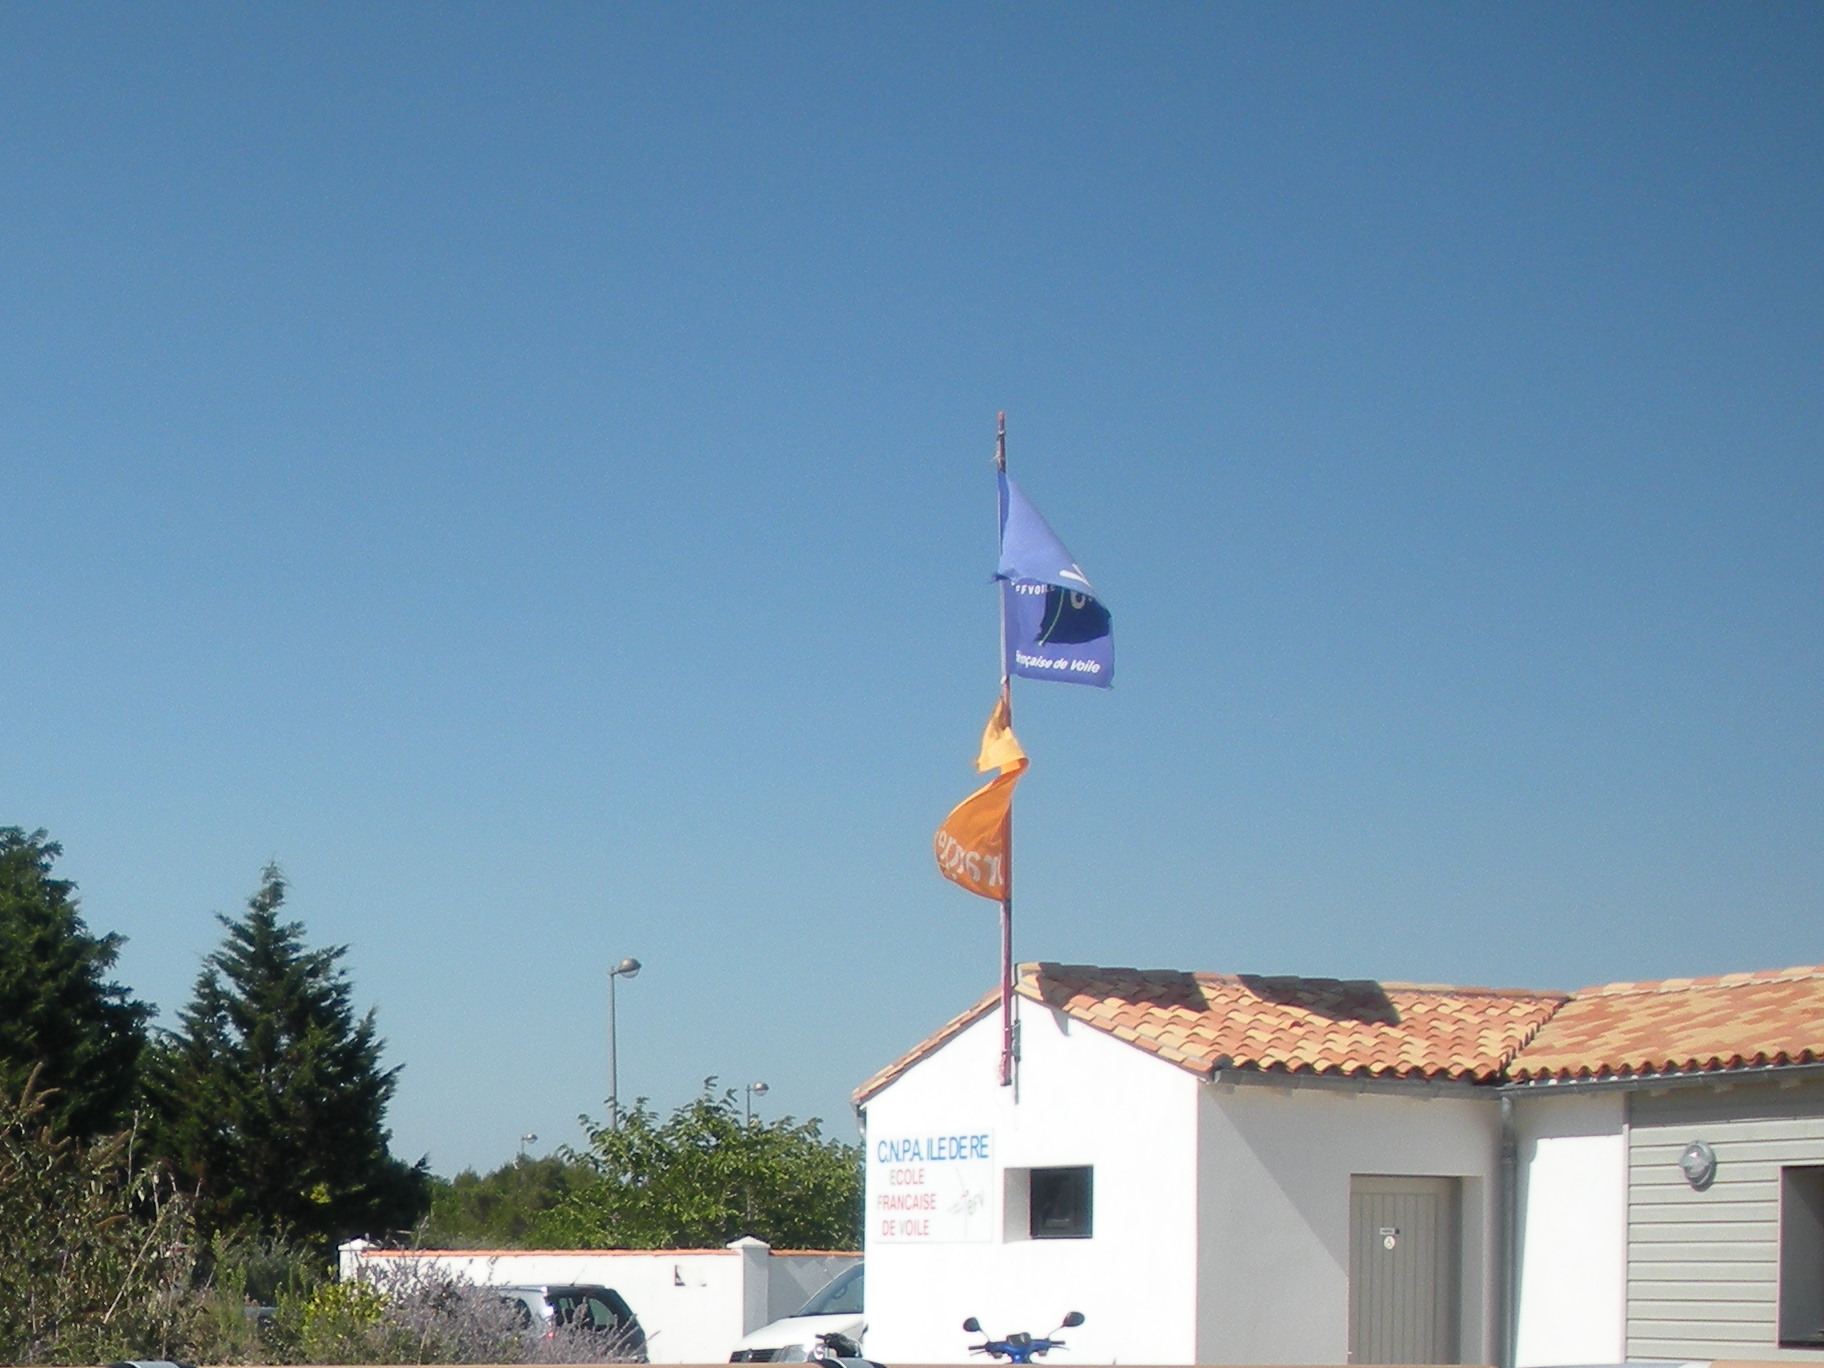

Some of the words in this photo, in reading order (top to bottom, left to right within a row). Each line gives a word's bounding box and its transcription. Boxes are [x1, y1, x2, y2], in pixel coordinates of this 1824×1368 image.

[1053, 658, 1068, 670] de
[1070, 659, 1100, 673] Voile
[927, 1137, 947, 1160] ILE
[949, 1136, 968, 1159] DE
[971, 1134, 989, 1158] RE
[890, 1168, 924, 1185] ECOLE
[878, 1193, 936, 1210] FRANCAISE
[882, 1220, 896, 1236] DE
[899, 1219, 930, 1236] VOILE
